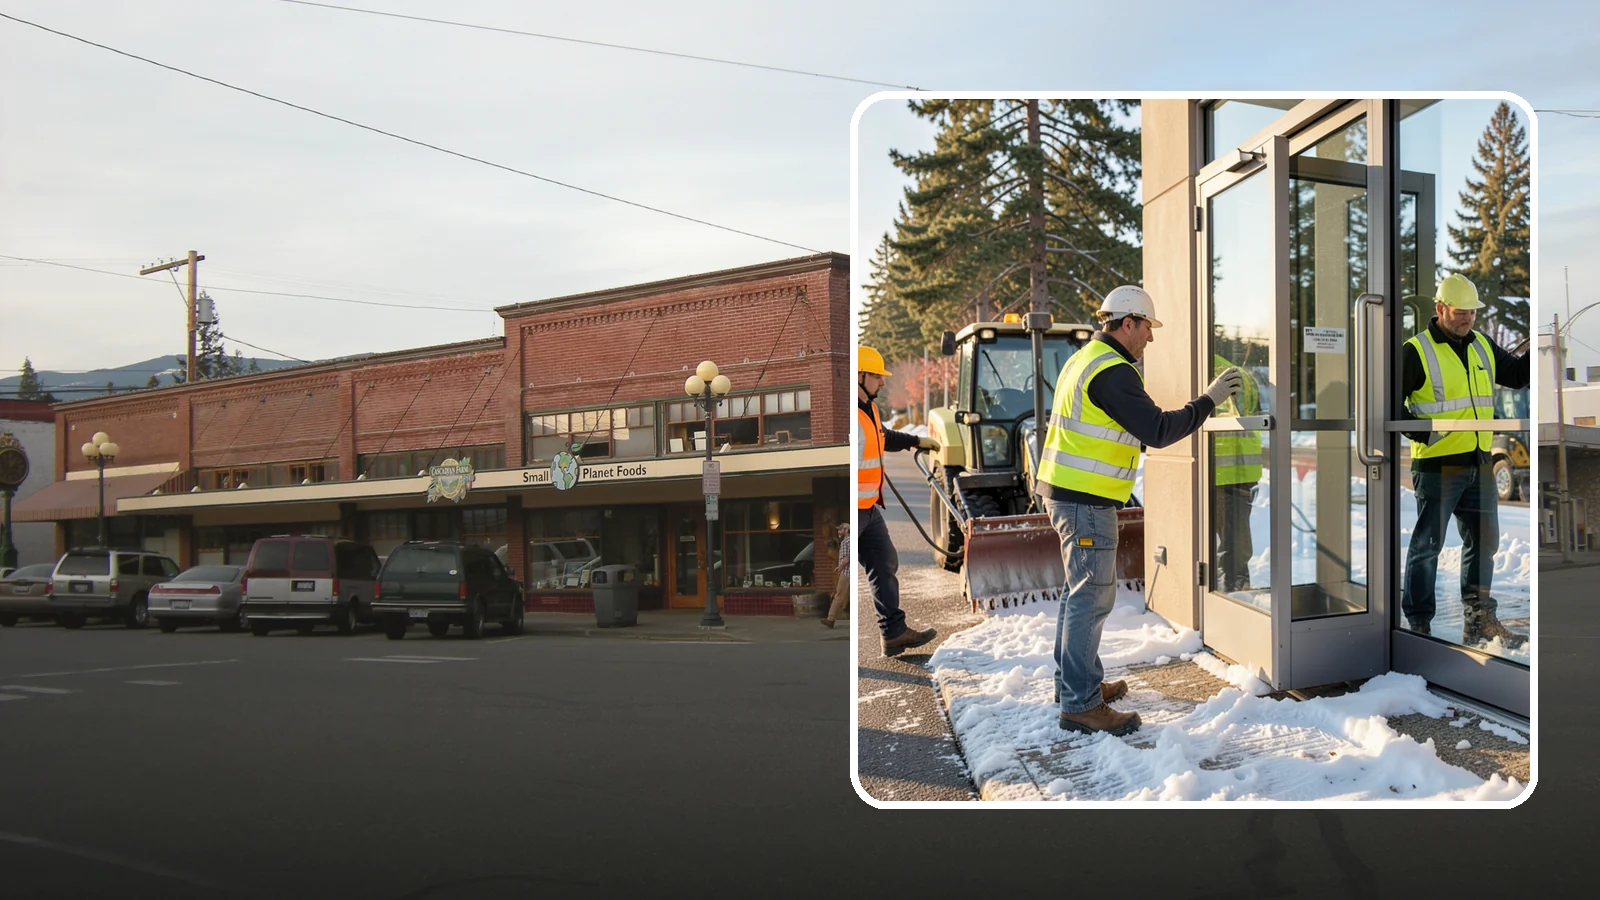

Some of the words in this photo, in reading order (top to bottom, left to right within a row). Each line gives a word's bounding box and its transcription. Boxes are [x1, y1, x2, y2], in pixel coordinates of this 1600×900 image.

[523, 471, 549, 482] Small
[582, 467, 614, 479] Planet
[617, 465, 647, 477] Foods
